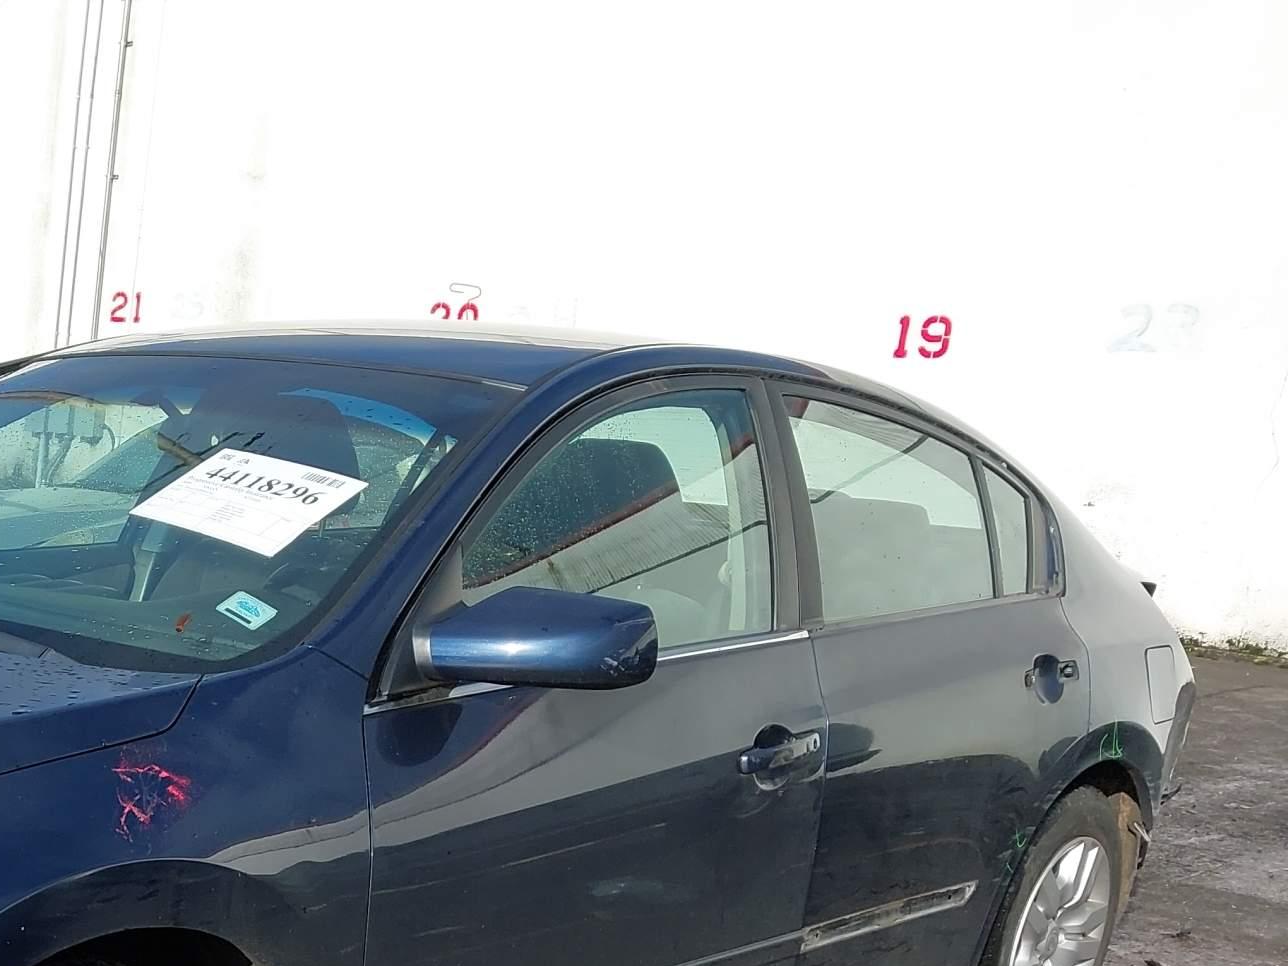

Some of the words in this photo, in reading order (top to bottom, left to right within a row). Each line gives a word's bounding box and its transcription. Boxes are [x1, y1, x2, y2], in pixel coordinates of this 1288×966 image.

[109, 291, 142, 323] 21
[892, 314, 953, 359] 19
[205, 466, 323, 505] 44118296
